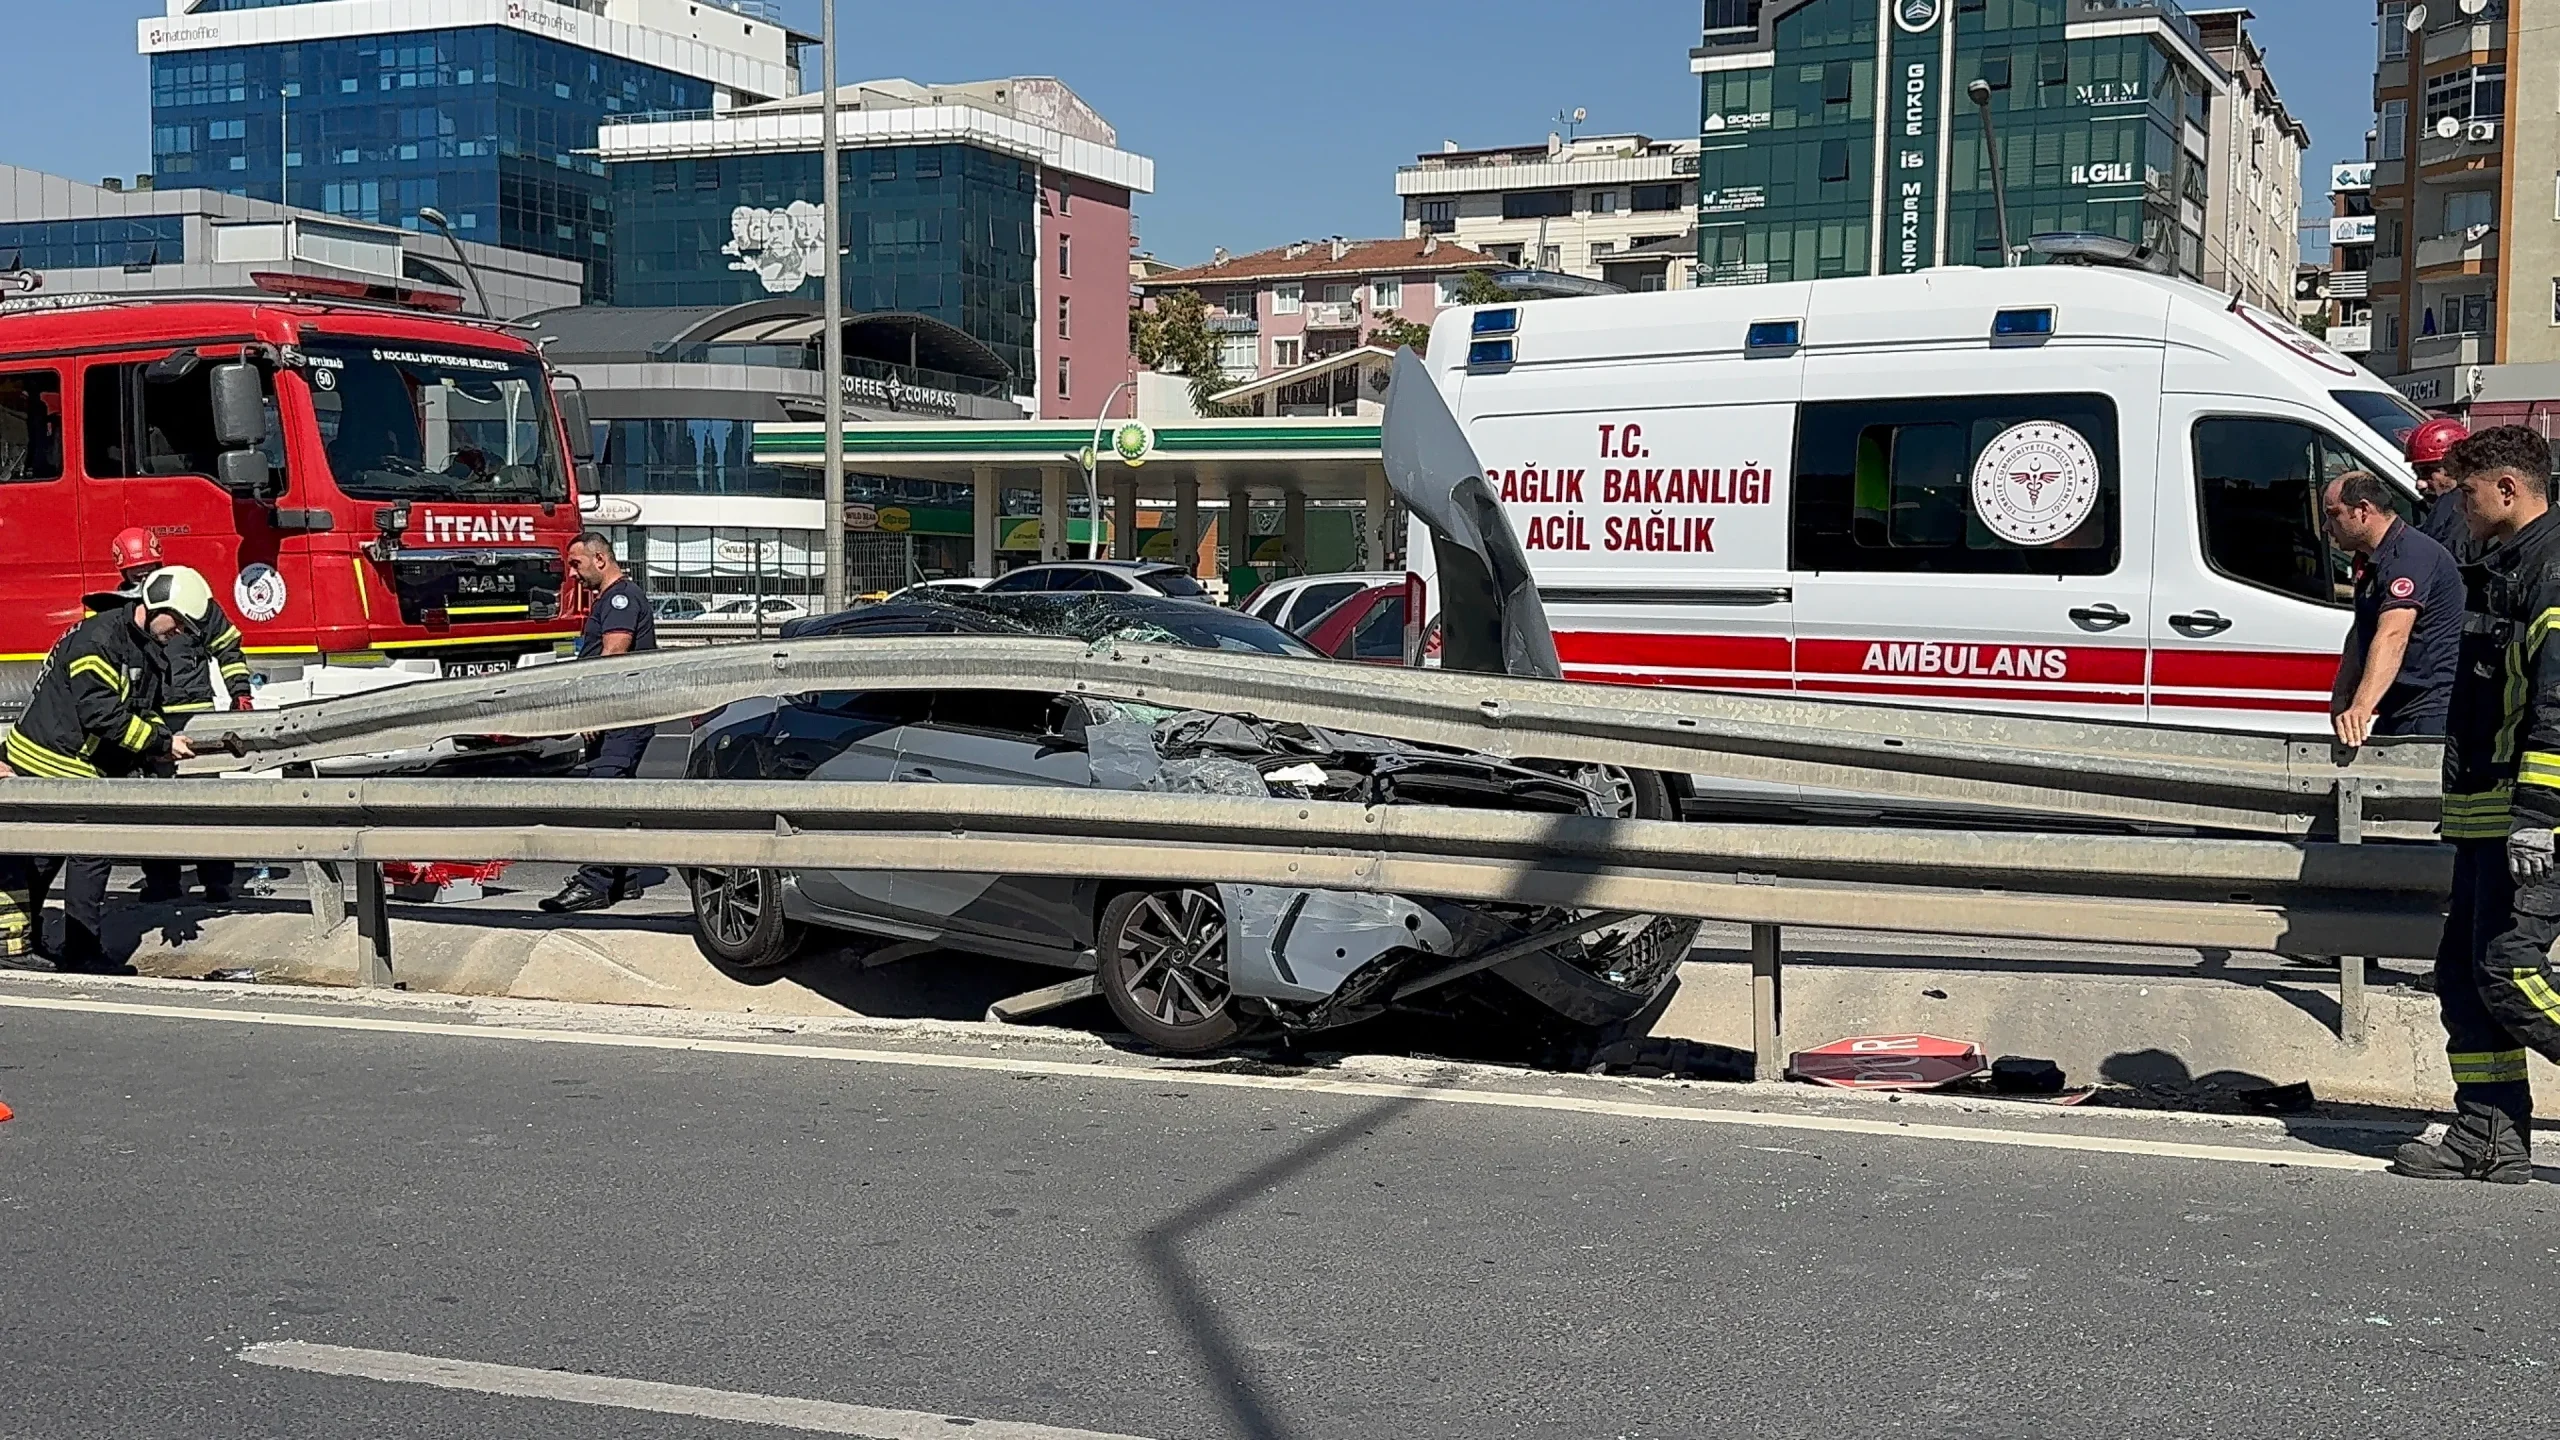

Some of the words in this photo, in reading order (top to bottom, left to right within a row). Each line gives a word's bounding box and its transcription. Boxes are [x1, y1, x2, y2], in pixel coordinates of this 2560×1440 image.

[162, 26, 218, 42] matchoffice
[318, 371, 331, 386] 50
[905, 387, 957, 407] COMPASS
[1598, 423, 1649, 458] T.C.
[1603, 460, 1772, 504] BAKANLIĞI
[424, 509, 536, 543] İTFAİYE
[1526, 509, 1590, 551] ACİL
[1604, 509, 1715, 552] SAĞLIK
[457, 575, 516, 593] MAN
[449, 665, 461, 678] 41
[1862, 643, 2067, 679] AMBULANS
